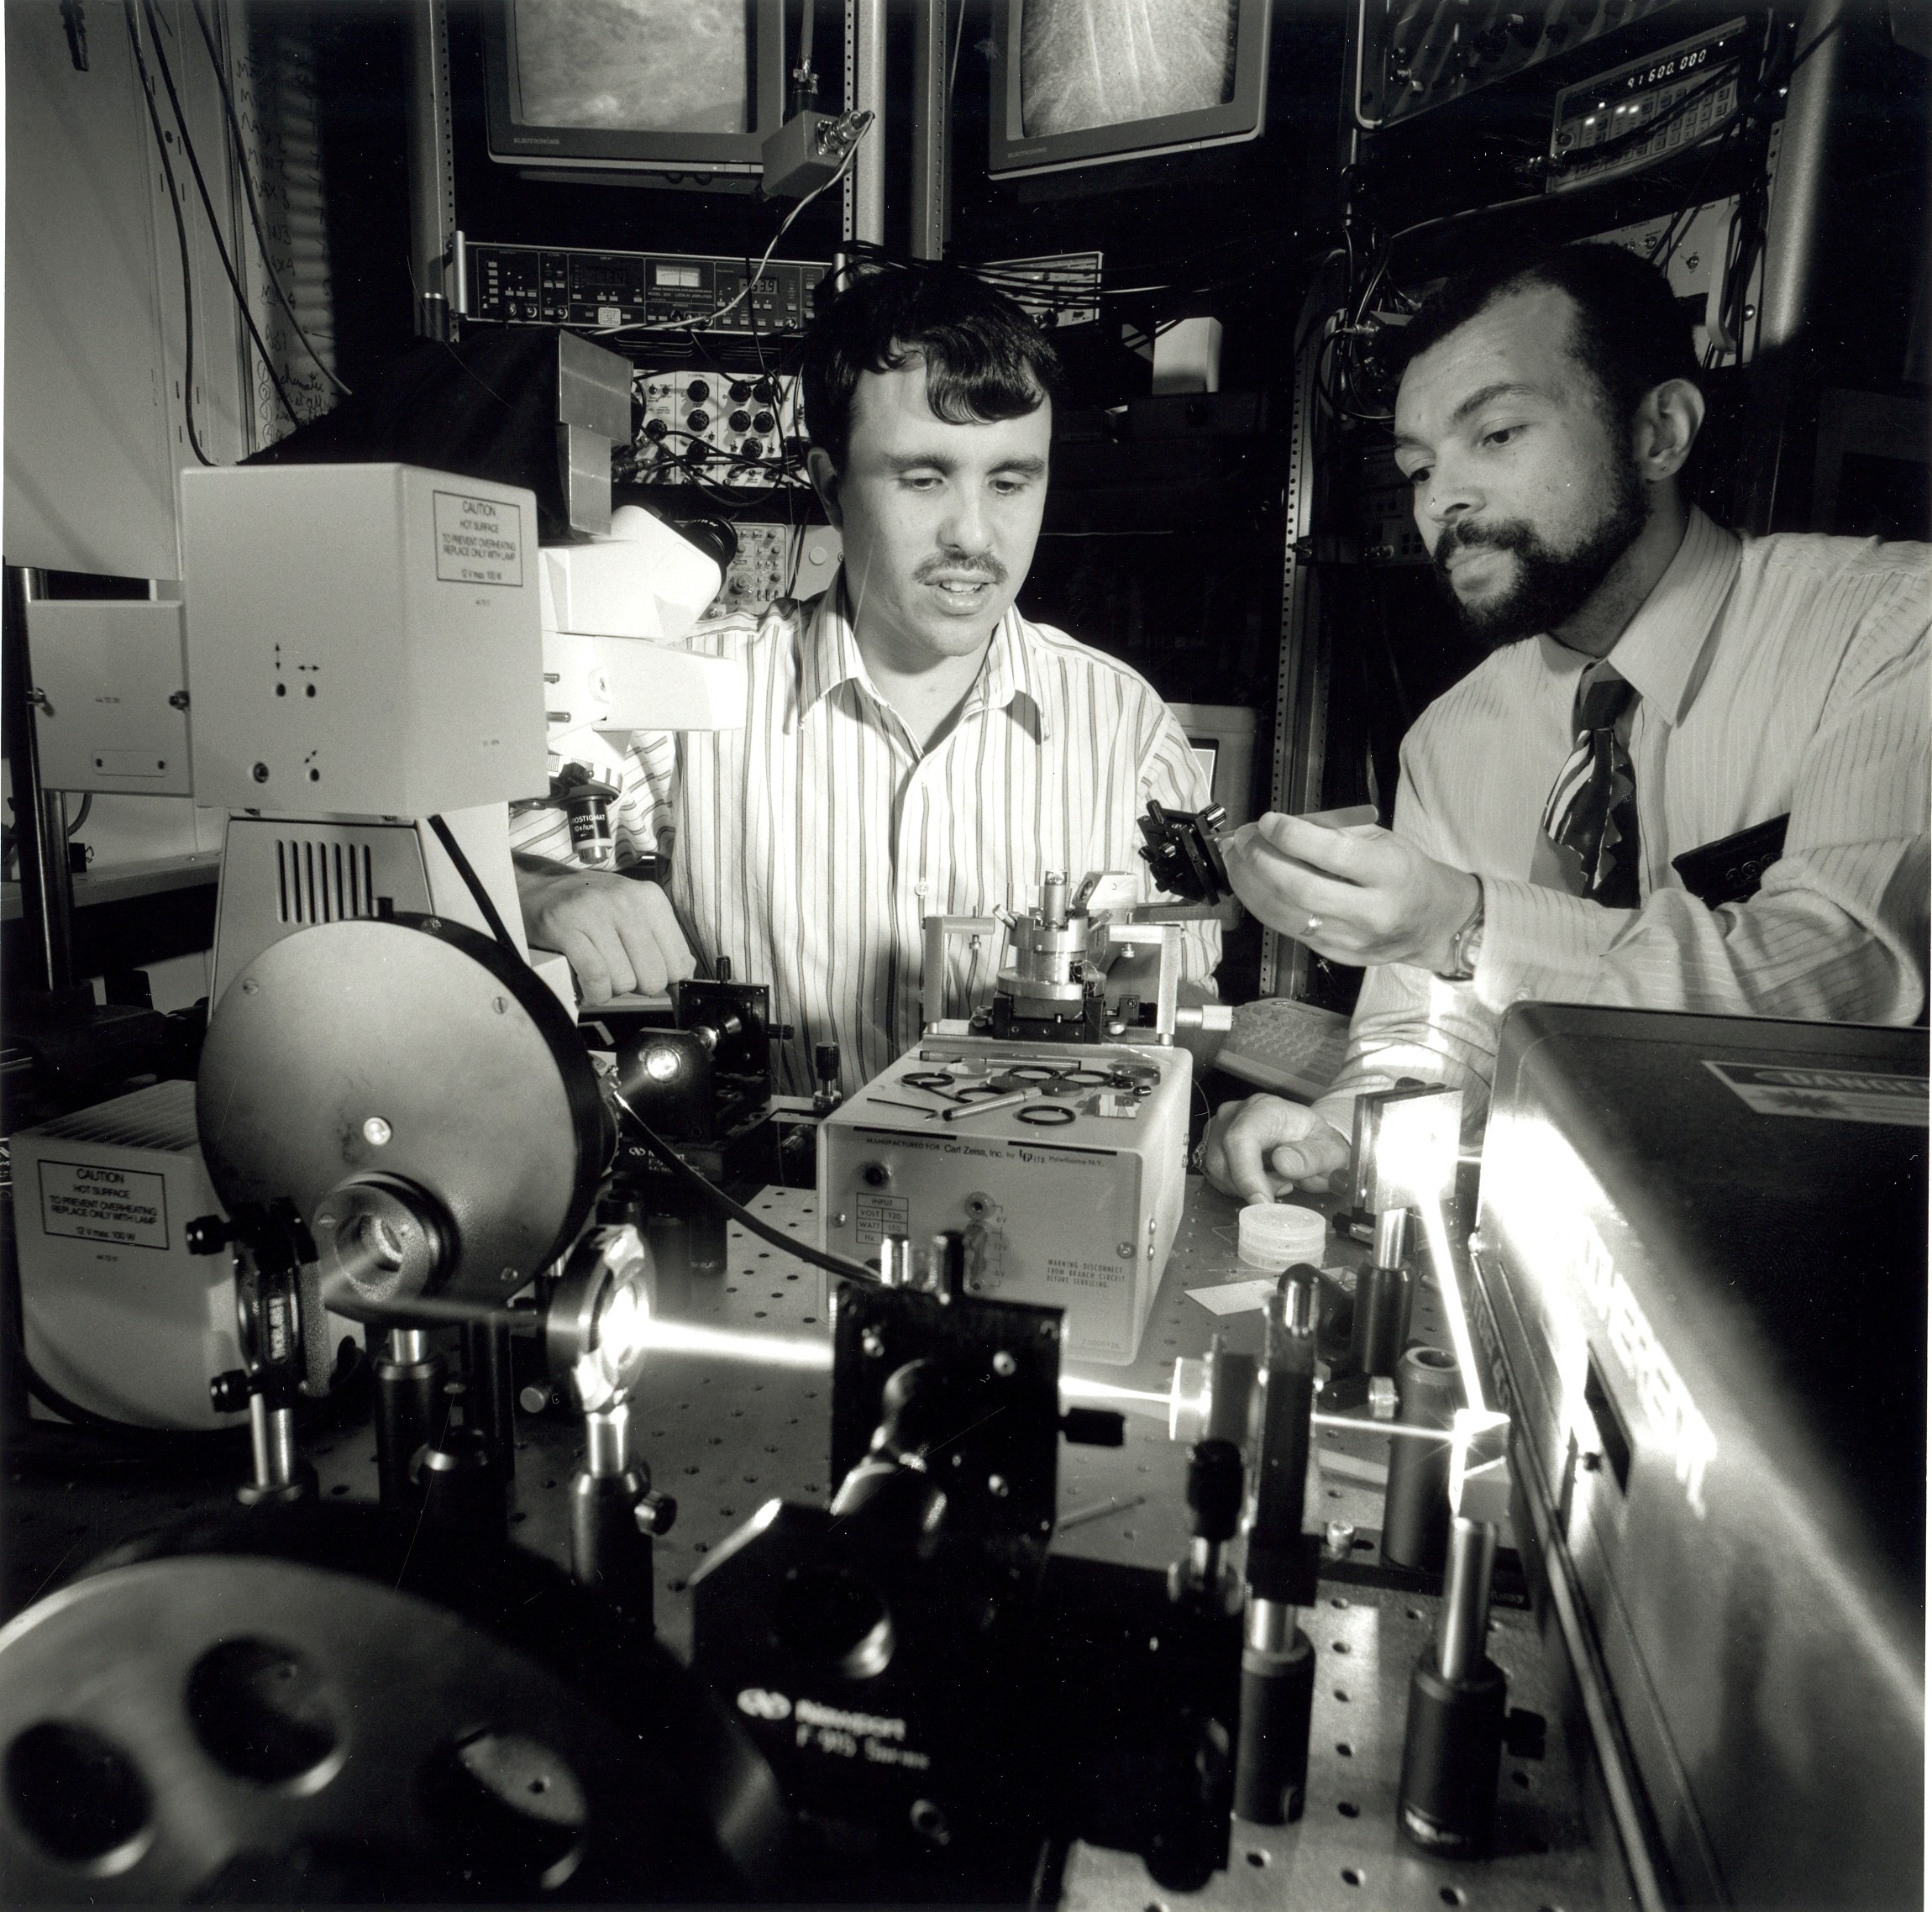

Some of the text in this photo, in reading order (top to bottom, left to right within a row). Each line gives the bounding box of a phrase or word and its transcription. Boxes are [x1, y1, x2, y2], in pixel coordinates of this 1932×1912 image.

[463, 501, 496, 517] CAUTION
[866, 1137, 923, 1150] MANUFACTURED
[944, 1143, 961, 1153] Carl
[963, 1146, 988, 1158] Zeiss,
[76, 1168, 125, 1184] CAUTION
[73, 1183, 130, 1199] HOT SURFACE
[50, 1195, 157, 1216] TO PREVENT OVERHEATING
[871, 1198, 893, 1206] INPUT
[51, 1205, 157, 1226] REPLACE ONLY WITH LAMP
[860, 1209, 901, 1220] VOLT 120
[76, 1226, 84, 1235] 12
[112, 1232, 125, 1241] 100
[127, 1232, 135, 1242] W
[889, 1224, 901, 1232] 150
[1047, 1267, 1125, 1283] FROM BRANCH CIRCUIT
[1083, 1263, 1123, 1274] DISCONNECT
[1047, 1274, 1068, 1284] BEFORE
[795, 1699, 906, 1741] Newport
